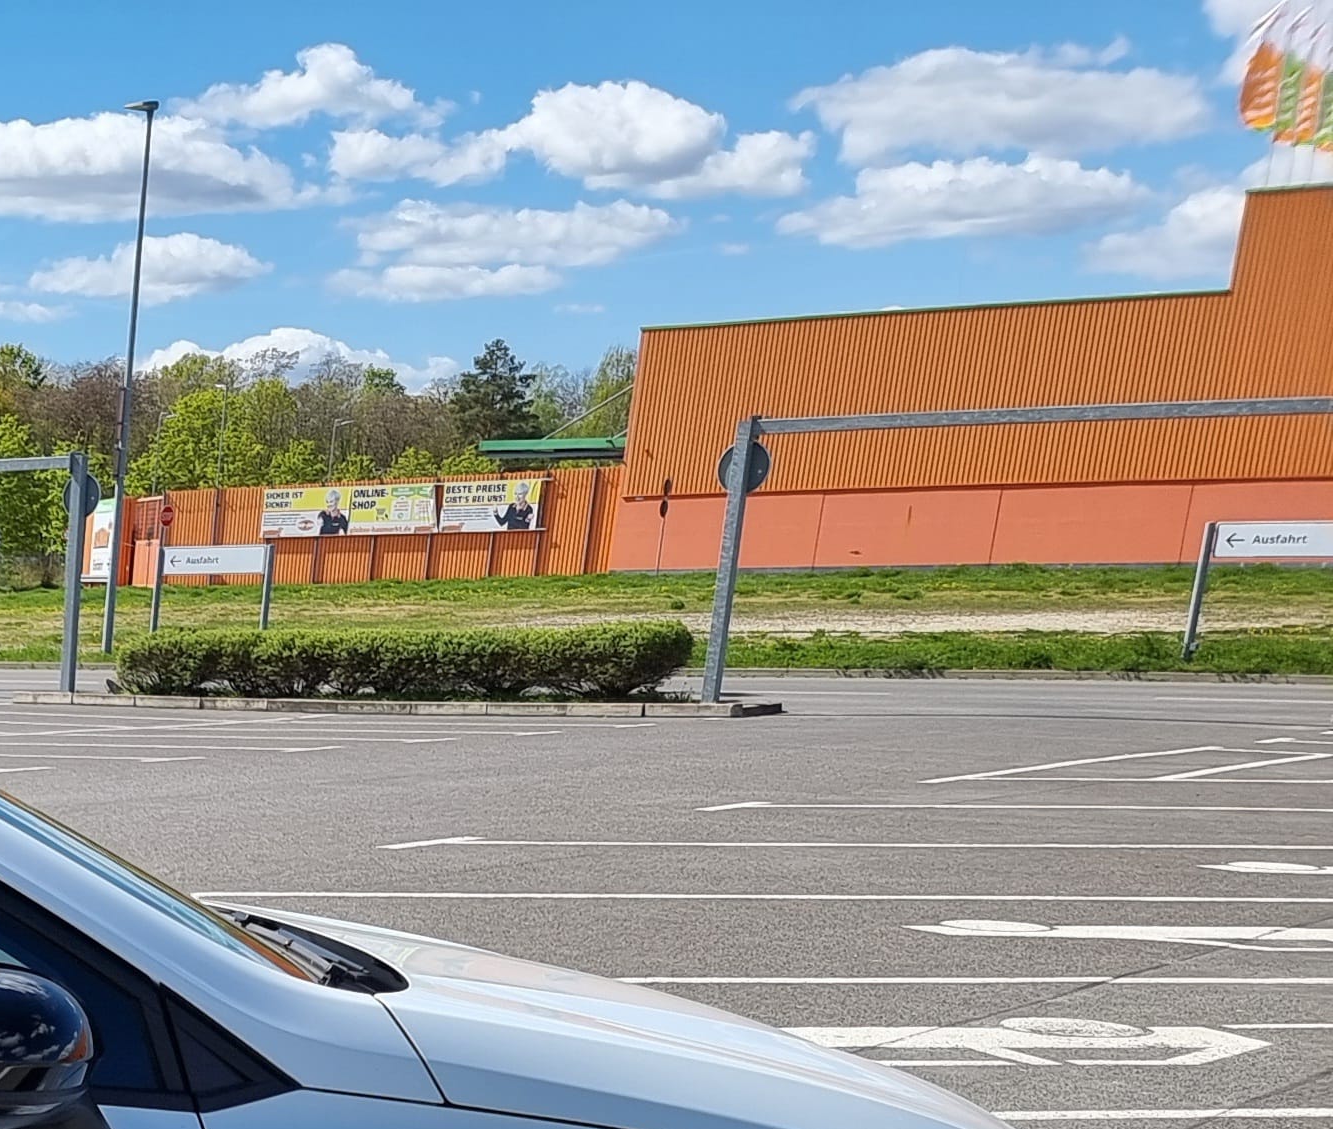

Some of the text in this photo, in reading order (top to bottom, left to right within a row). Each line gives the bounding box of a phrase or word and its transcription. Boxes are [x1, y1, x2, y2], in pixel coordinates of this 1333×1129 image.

[445, 483, 507, 494] BESTE PREISE
[351, 500, 377, 510] SHOP
[1252, 534, 1308, 544] Ausfahrt
[186, 556, 219, 564] Ausfahrt
